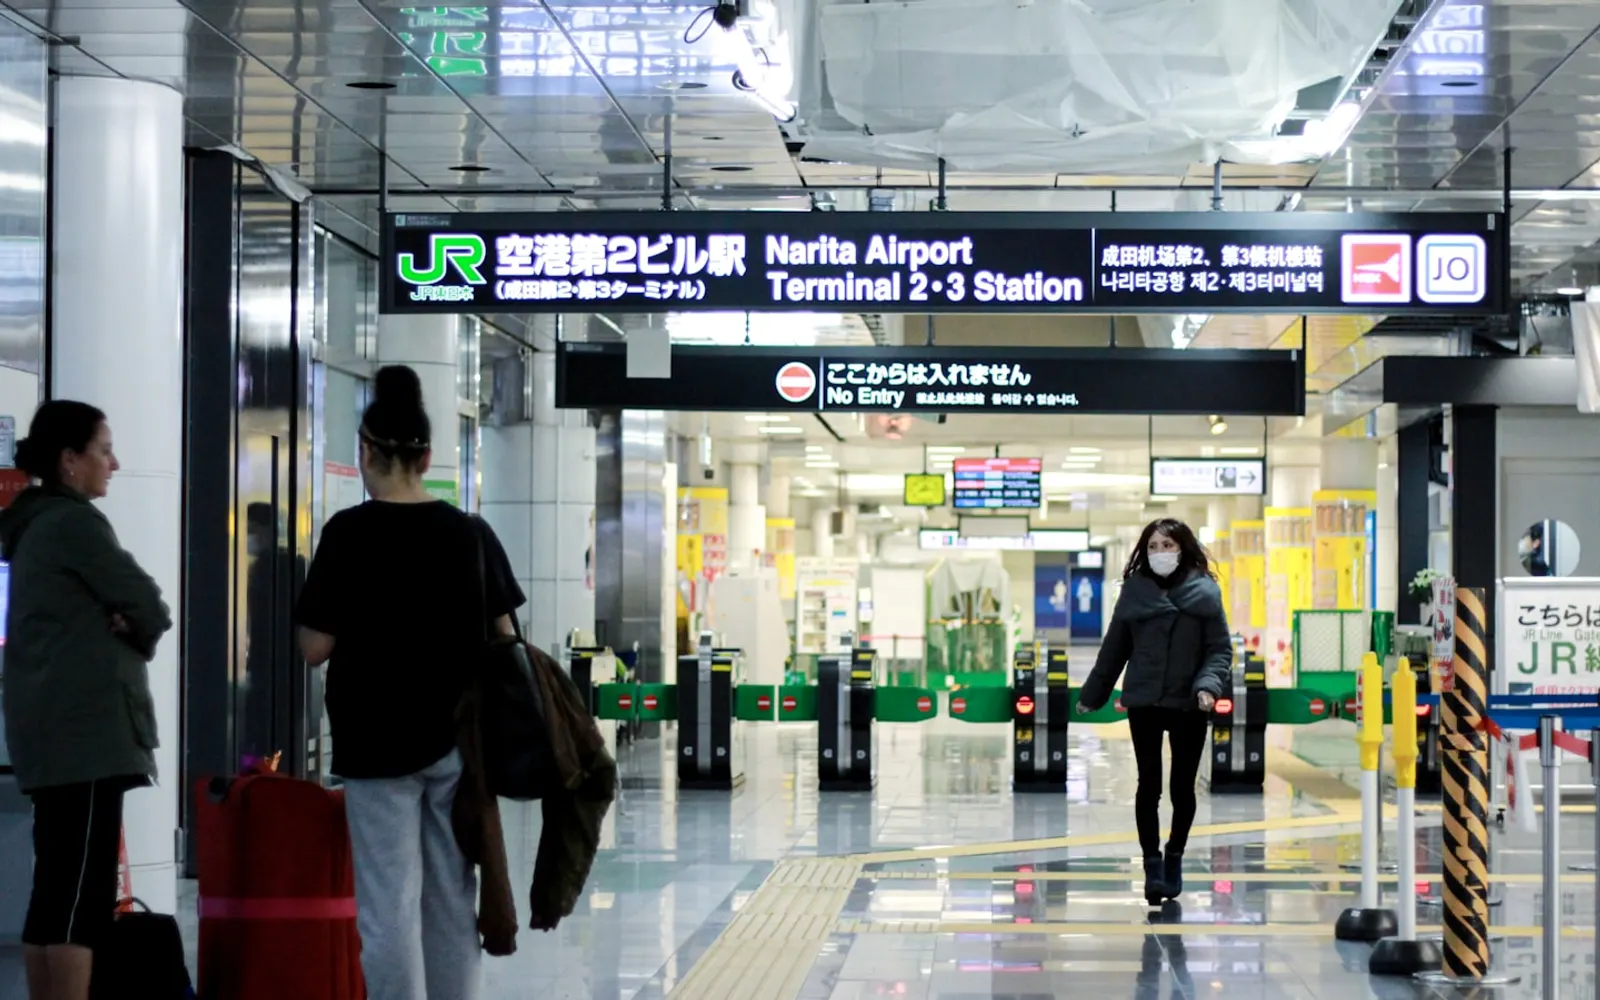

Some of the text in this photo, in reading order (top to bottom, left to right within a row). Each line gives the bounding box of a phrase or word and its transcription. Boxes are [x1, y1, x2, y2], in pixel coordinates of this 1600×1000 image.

[398, 234, 487, 284] JR
[496, 234, 747, 276] 空港第2ビル駅
[766, 235, 973, 271] Narita Airport
[1433, 257, 1470, 281] JO
[766, 272, 900, 301] Terminal
[974, 271, 1082, 301] Station
[1101, 271, 1185, 292] 나리타공항
[827, 363, 1031, 386] ここからは入れません
[827, 387, 905, 408] No Entry
[1518, 604, 1600, 627] こちらは
